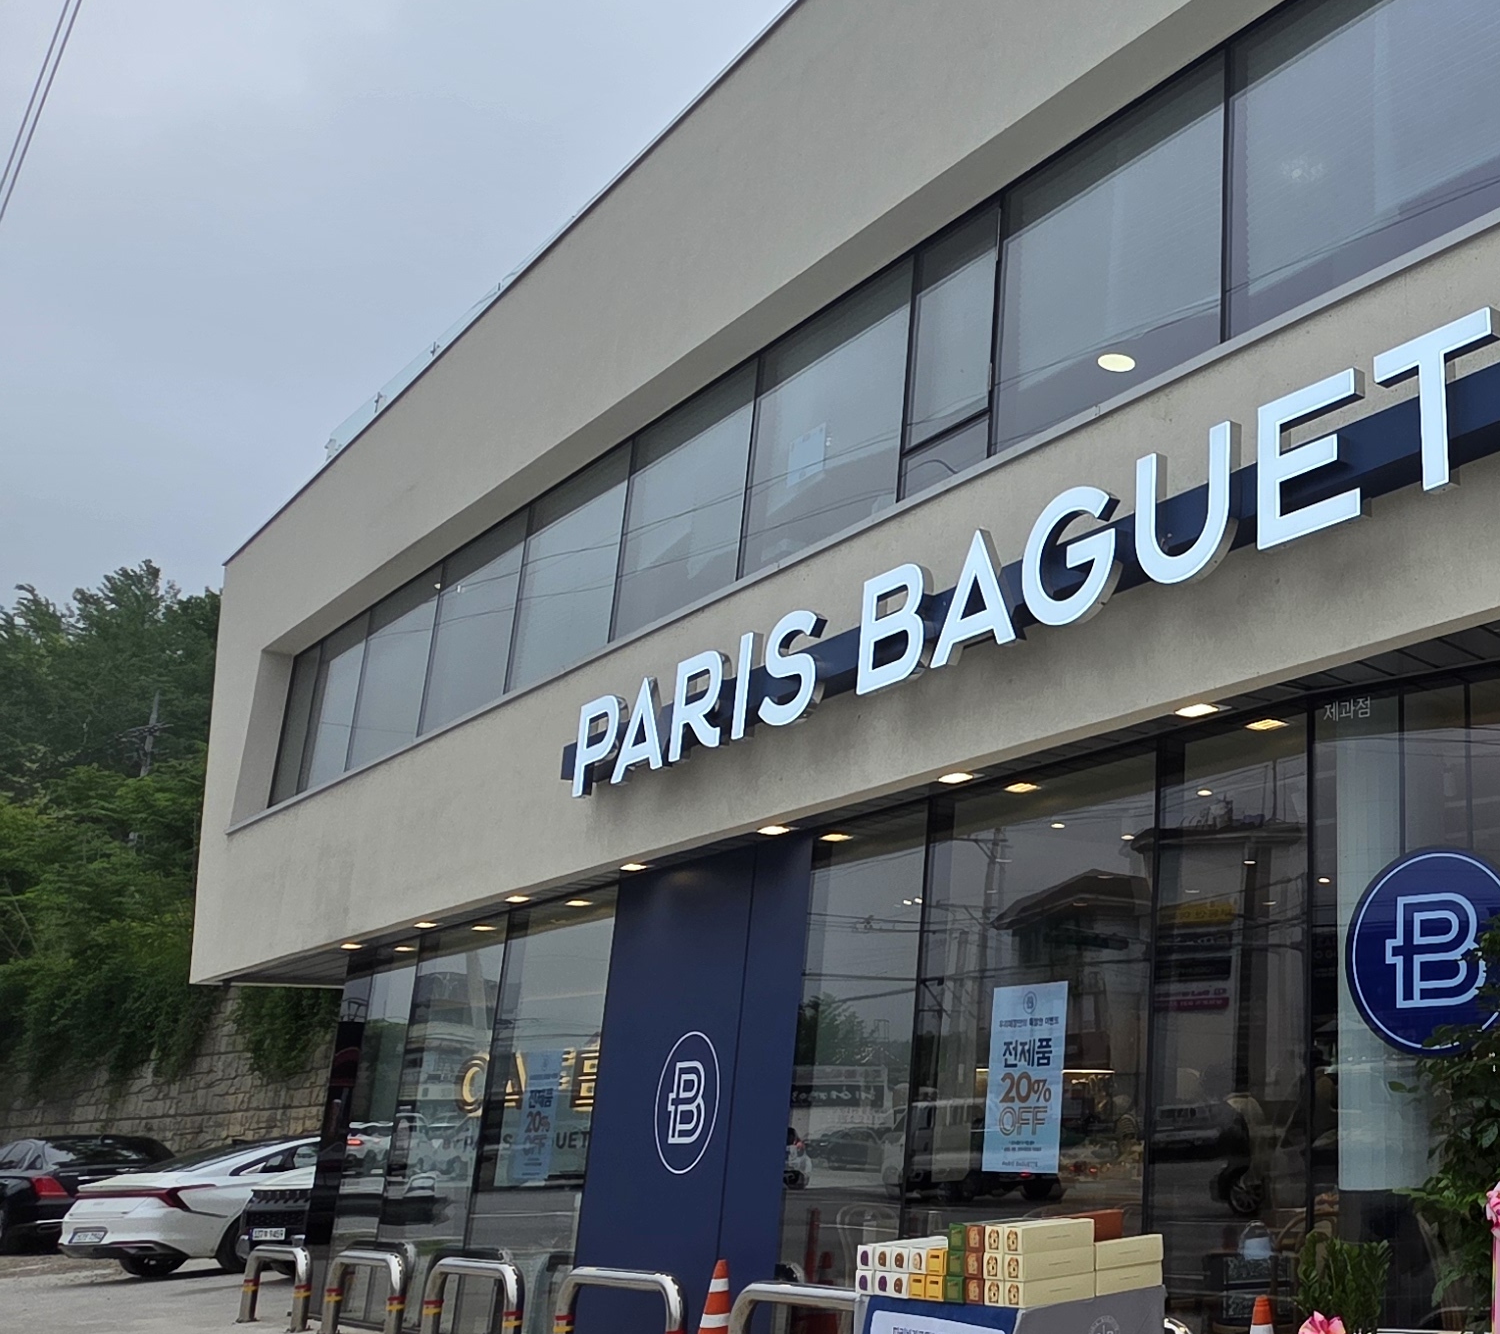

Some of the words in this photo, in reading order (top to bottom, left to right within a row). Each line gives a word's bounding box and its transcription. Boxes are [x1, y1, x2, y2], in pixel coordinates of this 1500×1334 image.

[570, 608, 828, 798] PARIS
[1323, 697, 1372, 722] 제과점
[1002, 1038, 1052, 1068] 전제품
[454, 1049, 600, 1115] CAE
[999, 1071, 1052, 1104] 20%
[524, 1110, 551, 1134] 20%
[998, 1106, 1048, 1136] OFF
